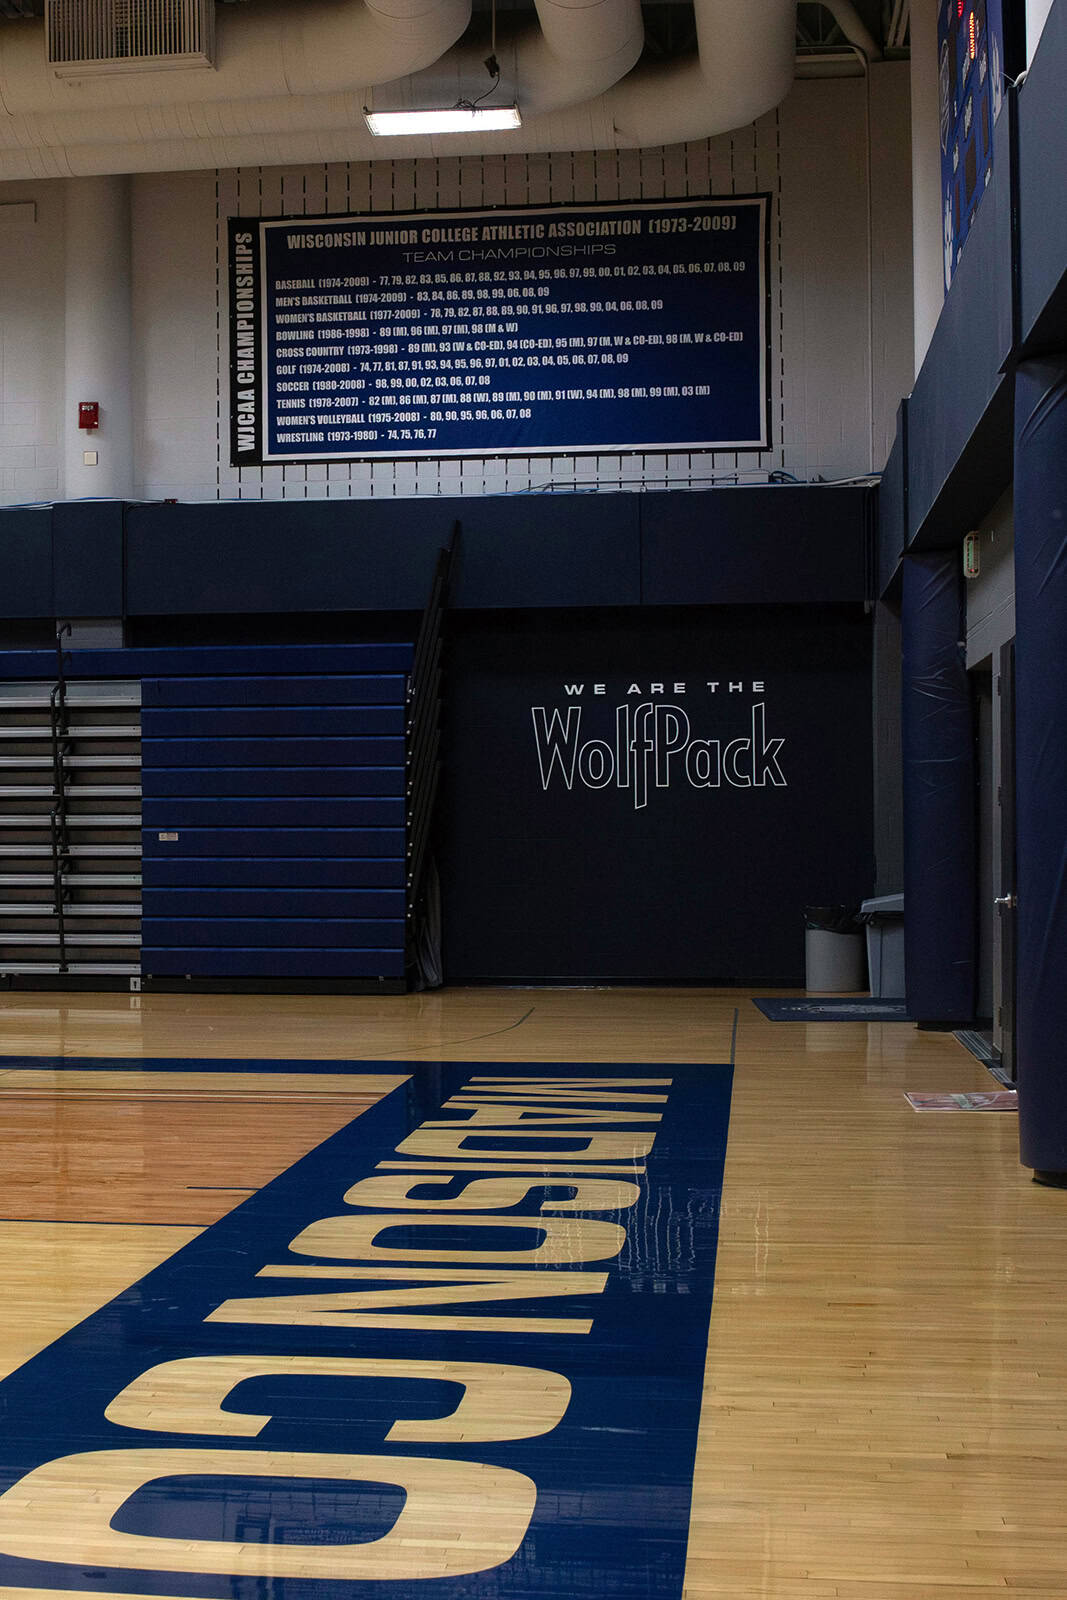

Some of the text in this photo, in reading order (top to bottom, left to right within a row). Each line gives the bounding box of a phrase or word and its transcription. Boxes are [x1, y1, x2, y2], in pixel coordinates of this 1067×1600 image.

[287, 231, 366, 249] WISCONSIN
[369, 229, 418, 245] JUNIOR
[421, 226, 478, 243] COLLEGE
[481, 223, 544, 241] ATHLETIC
[548, 218, 641, 238] ASSOCIATION
[402, 242, 616, 263] TEAM CHAMPIONSHIPS
[275, 278, 315, 290] BASEBALL
[275, 296, 300, 307] MEN'S
[301, 294, 352, 305] BASKETBALL
[275, 312, 314, 324] WOMEN'S
[315, 310, 366, 322] BASKETBALL
[275, 329, 314, 340] BOWLING
[236, 233, 255, 452] WJCAA CHAMPIONSHIPS
[275, 347, 304, 358] CROSS
[305, 345, 344, 356] COUNTRY
[474, 340, 505, 351] CO-ED),
[519, 338, 553, 349] (CO-ED),
[632, 334, 664, 345] CO-ED),
[713, 331, 743, 342] CO-ED)
[276, 364, 296, 375] GOLF
[276, 381, 309, 392] SOCCER
[276, 398, 305, 408] TENNIS
[276, 415, 315, 425] WOMEN'S
[317, 413, 364, 424] VOLLEYBALL
[276, 432, 324, 442] WRESTLING
[564, 682, 765, 695] WE ARE THE
[531, 702, 787, 809] WolfPack
[203, 1078, 673, 1334] MADISON
